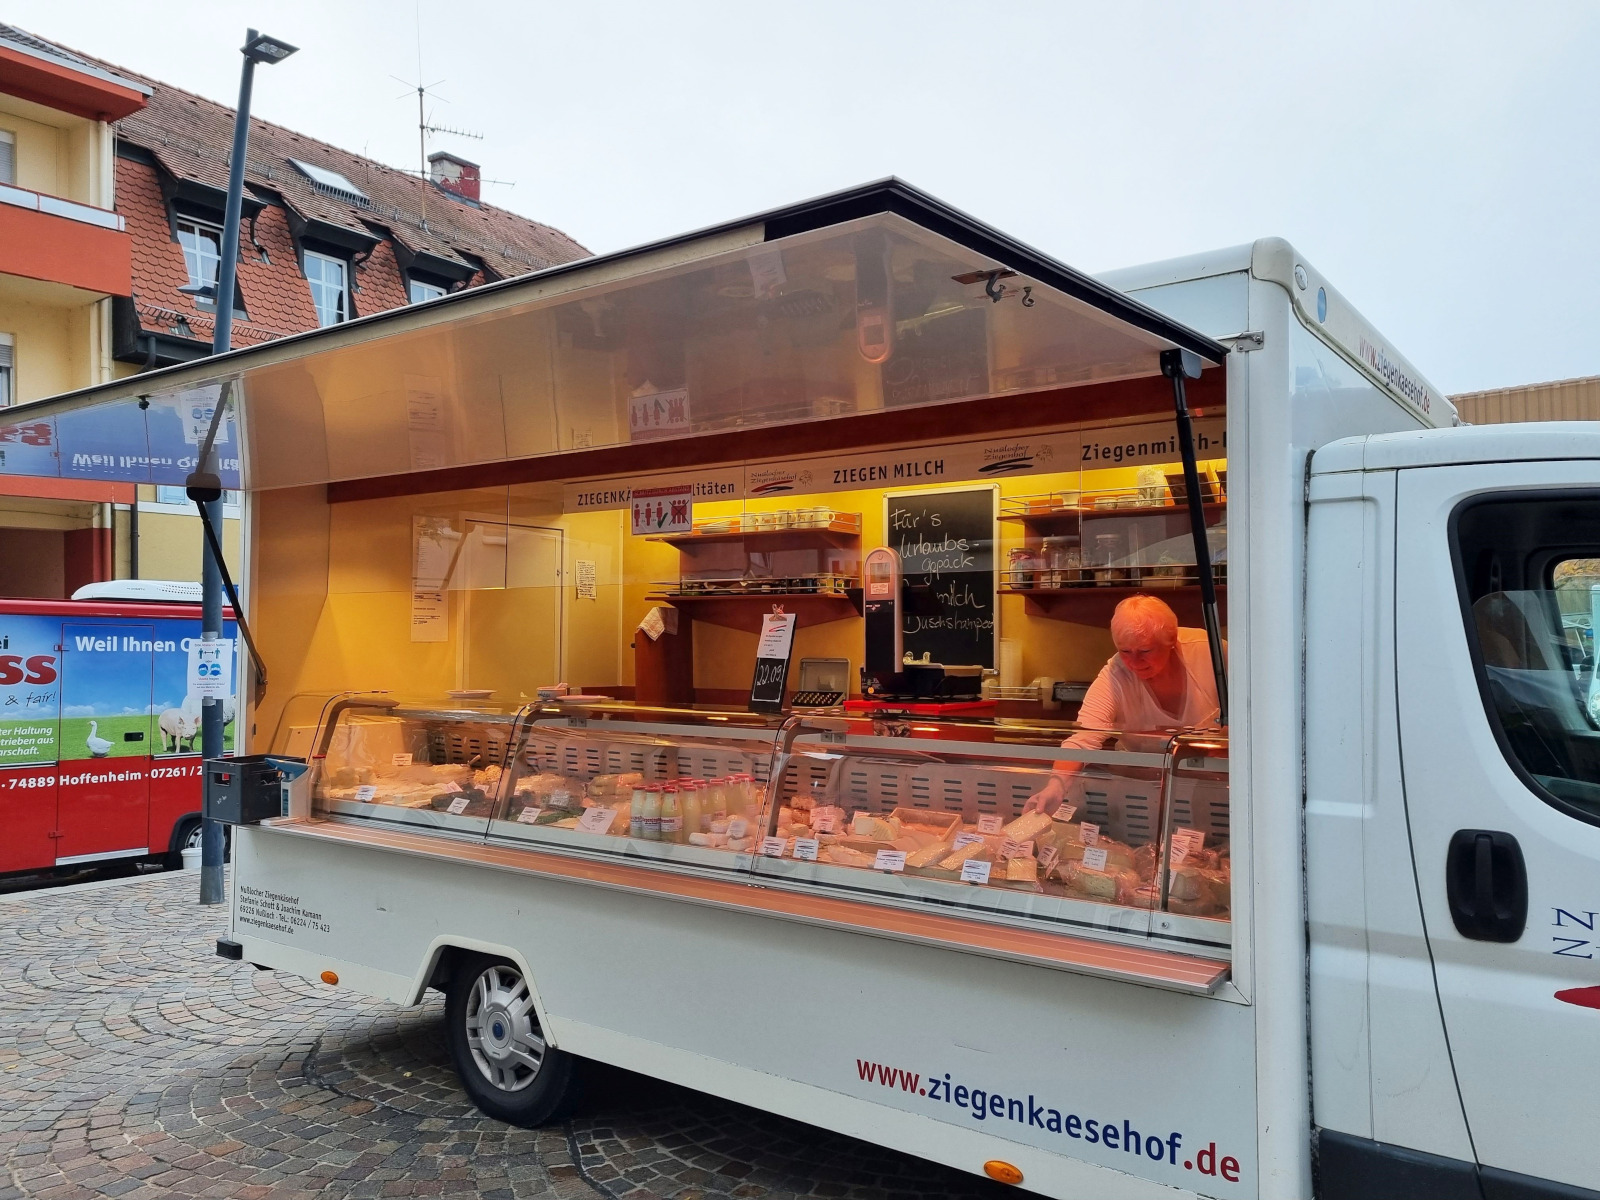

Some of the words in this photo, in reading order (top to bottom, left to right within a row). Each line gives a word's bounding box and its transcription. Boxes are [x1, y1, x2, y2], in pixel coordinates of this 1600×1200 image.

[833, 465, 887, 484] ZIEGEN
[894, 459, 944, 478] MILCH
[577, 486, 631, 506] ZIEGENKÄ
[692, 482, 735, 497] litäten
[75, 635, 118, 652] Weil
[123, 636, 176, 652] Ihnen
[26, 690, 57, 708] fair!
[14, 726, 53, 736] Haltung
[0, 737, 36, 746] trieben
[9, 776, 55, 790] 74889
[59, 770, 142, 786] Hoffenheim
[150, 766, 187, 779] 07261
[240, 885, 264, 897] Nußlocher
[240, 894, 259, 906] Stefanie
[280, 903, 301, 916] Joachim
[239, 915, 294, 935] www.ziegenkaesehof.de
[290, 915, 307, 927] 06224
[312, 920, 319, 930] 75
[856, 1058, 1241, 1184] www.ziegenkaesehof.de
